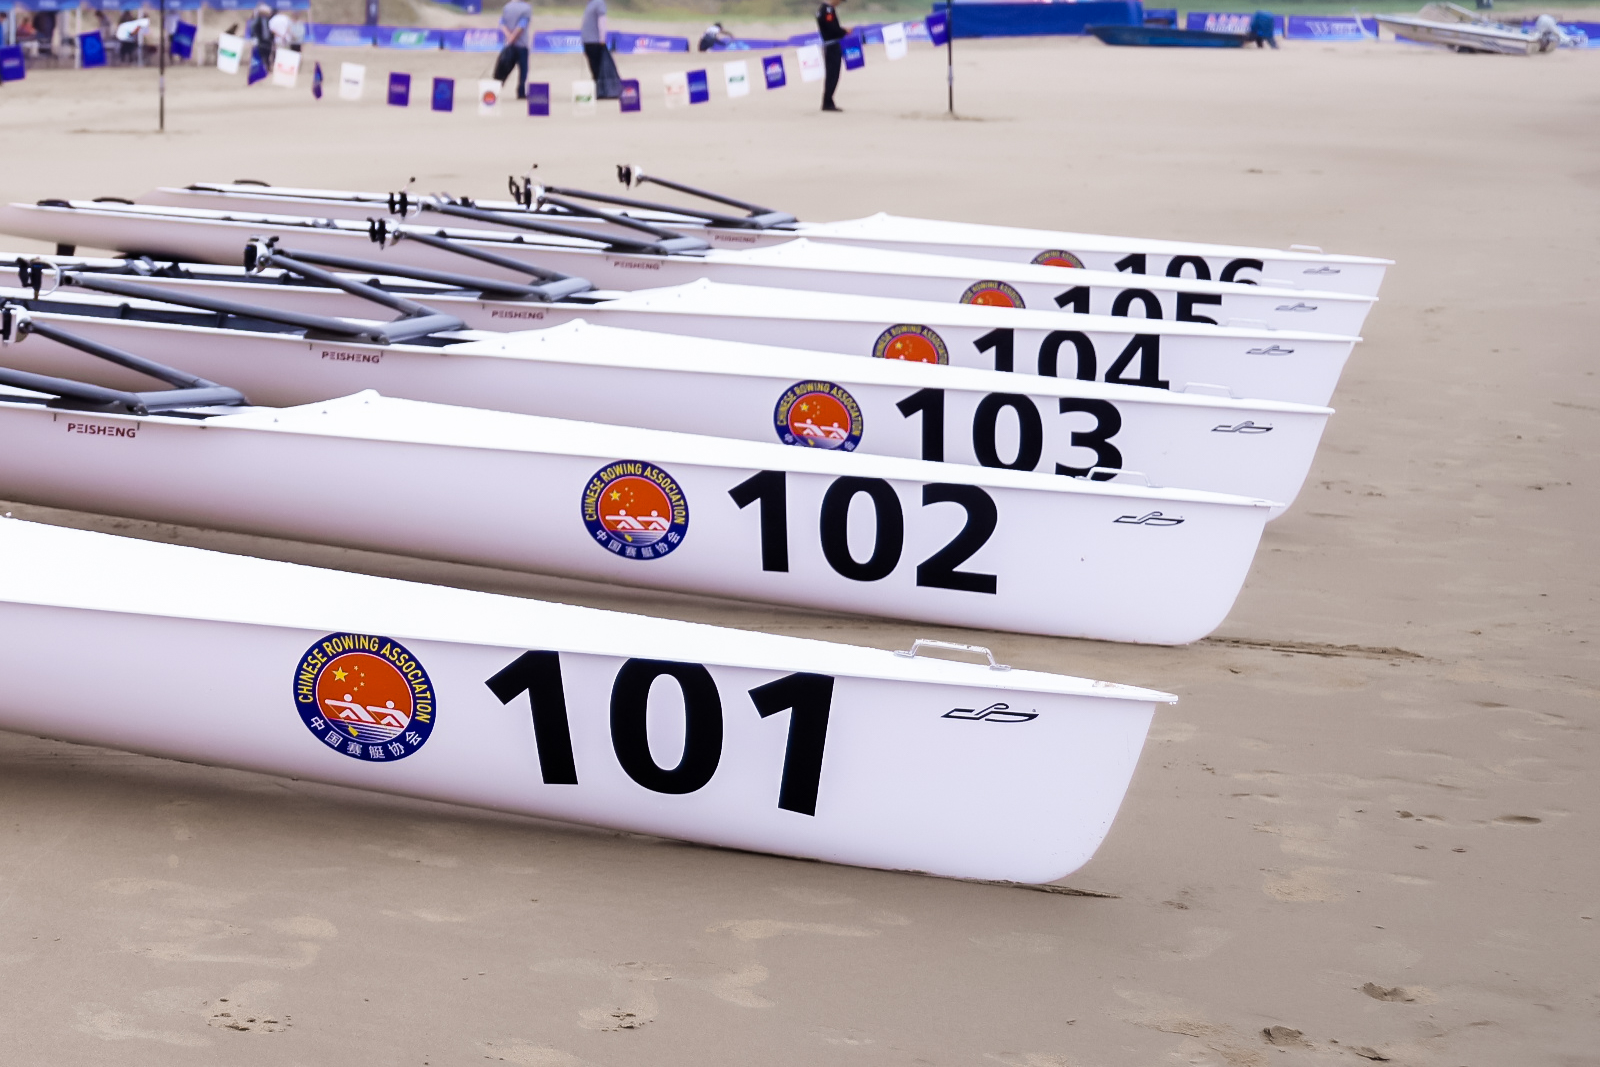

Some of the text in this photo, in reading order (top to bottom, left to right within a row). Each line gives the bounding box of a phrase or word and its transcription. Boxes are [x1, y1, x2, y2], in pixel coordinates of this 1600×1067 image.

[322, 351, 380, 364] PEISHENG
[972, 328, 1170, 391] 104
[67, 422, 136, 438] PEISHENG
[895, 388, 1123, 482] 103
[584, 463, 686, 525] CHINESE ROWING ASSOCIATION
[728, 469, 1000, 596] 102
[297, 634, 433, 724] CHINESE ROWING ASSOCIATION
[310, 716, 423, 759] 中国赛艇协会
[484, 649, 835, 817] 101
